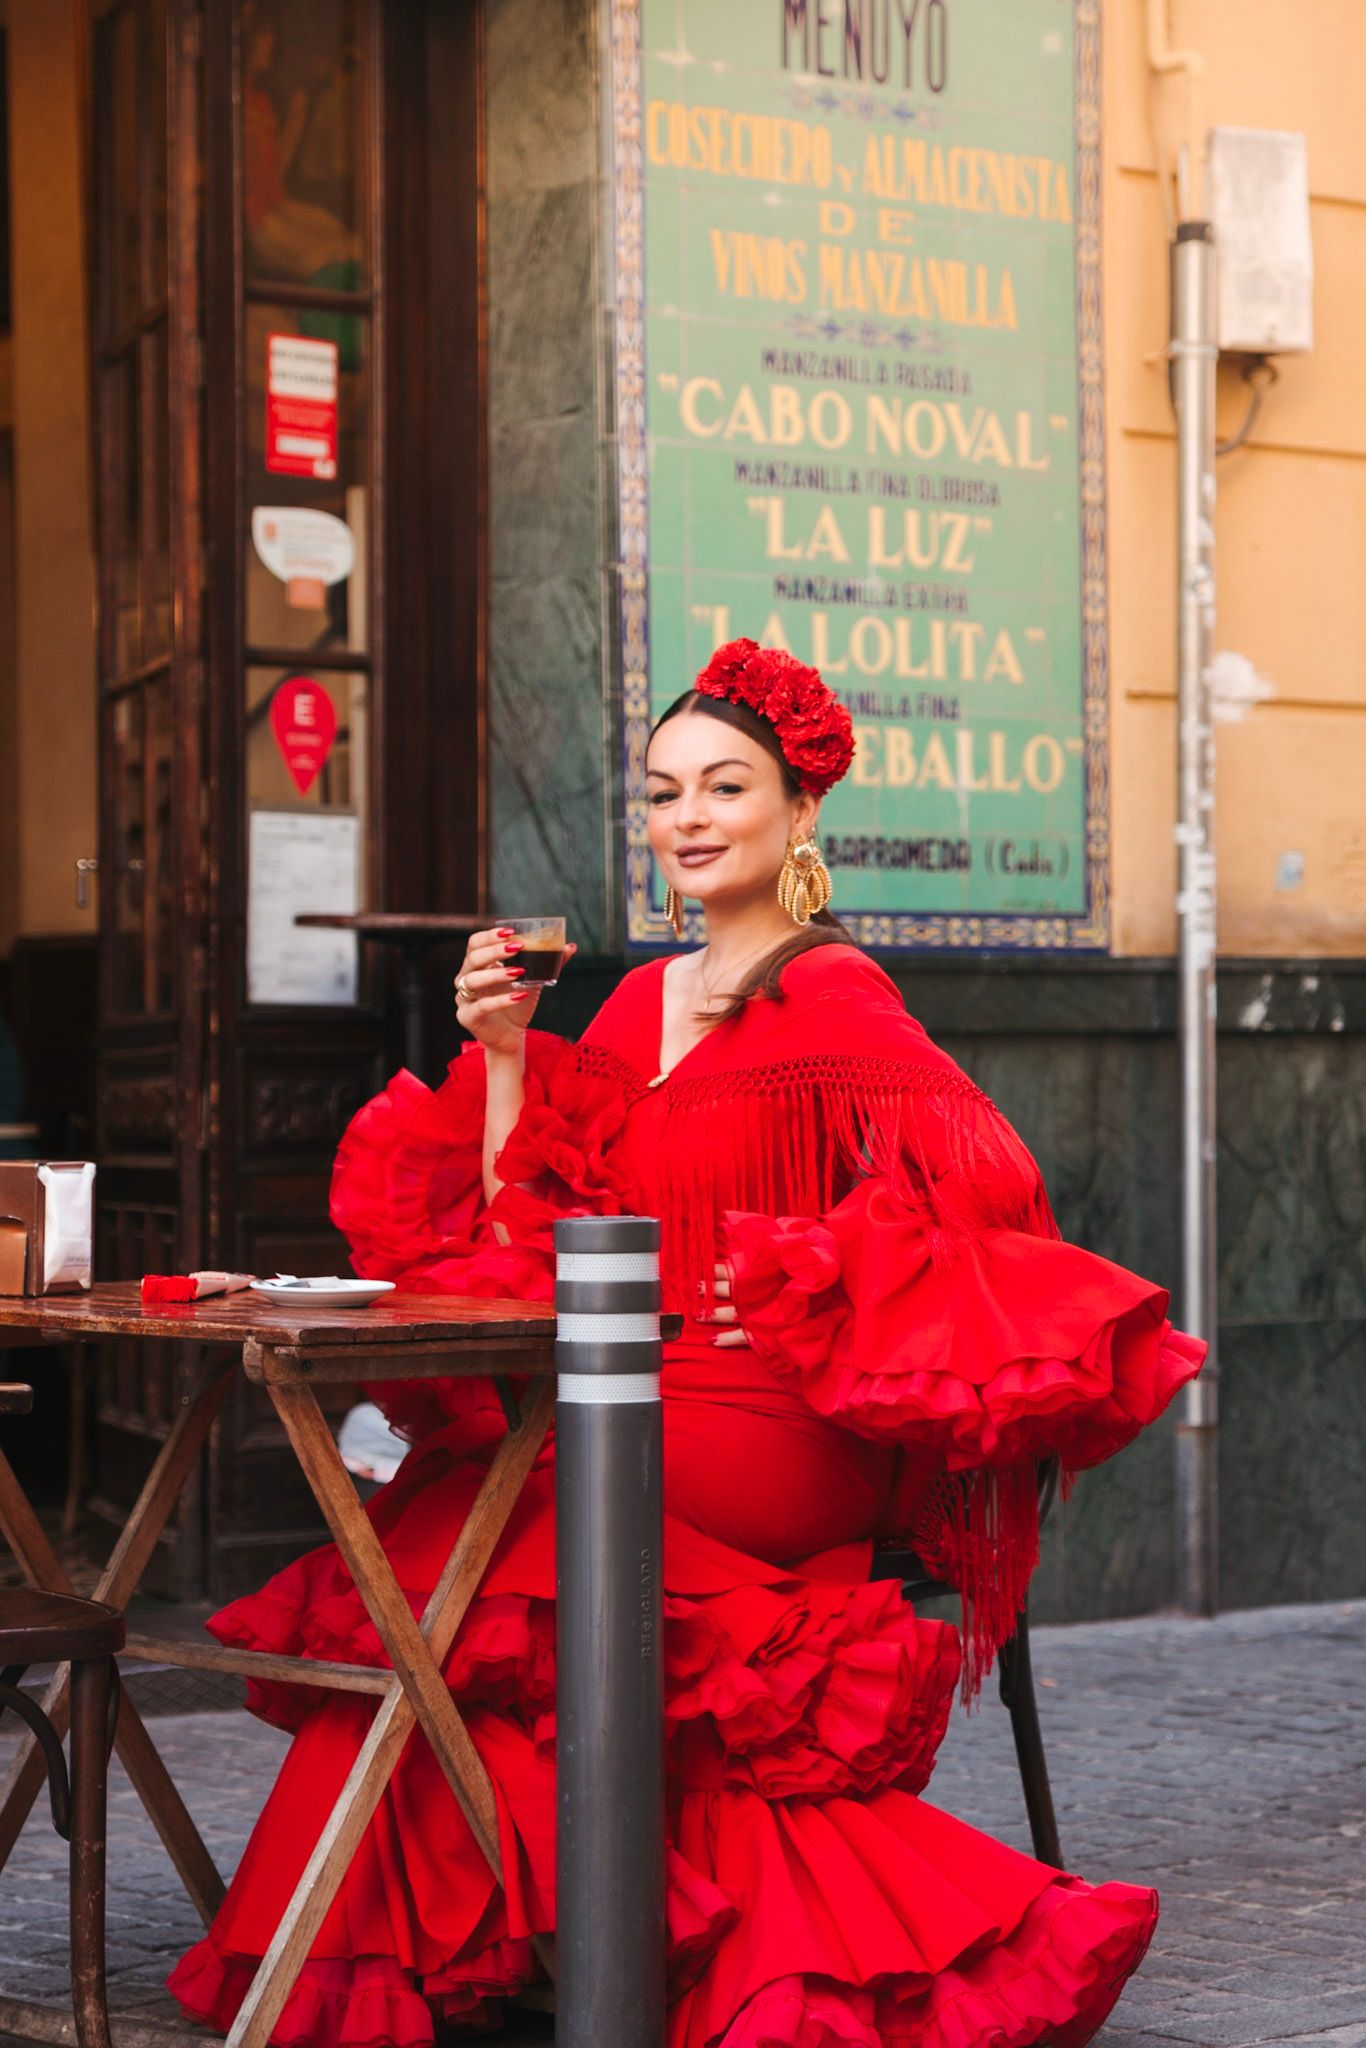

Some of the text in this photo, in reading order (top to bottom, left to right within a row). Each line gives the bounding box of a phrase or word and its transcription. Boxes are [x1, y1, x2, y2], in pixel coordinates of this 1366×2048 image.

[780, 0, 947, 93] MENUYO
[862, 132, 1073, 225] ALMACENISTA
[709, 228, 1019, 332] VINOS MANZANILLA
[762, 349, 889, 386] MANZANILLA
[734, 459, 861, 495] MANZANILLA
[773, 574, 898, 609] MANZANILLA
[825, 835, 972, 872] BARRAMEDA
